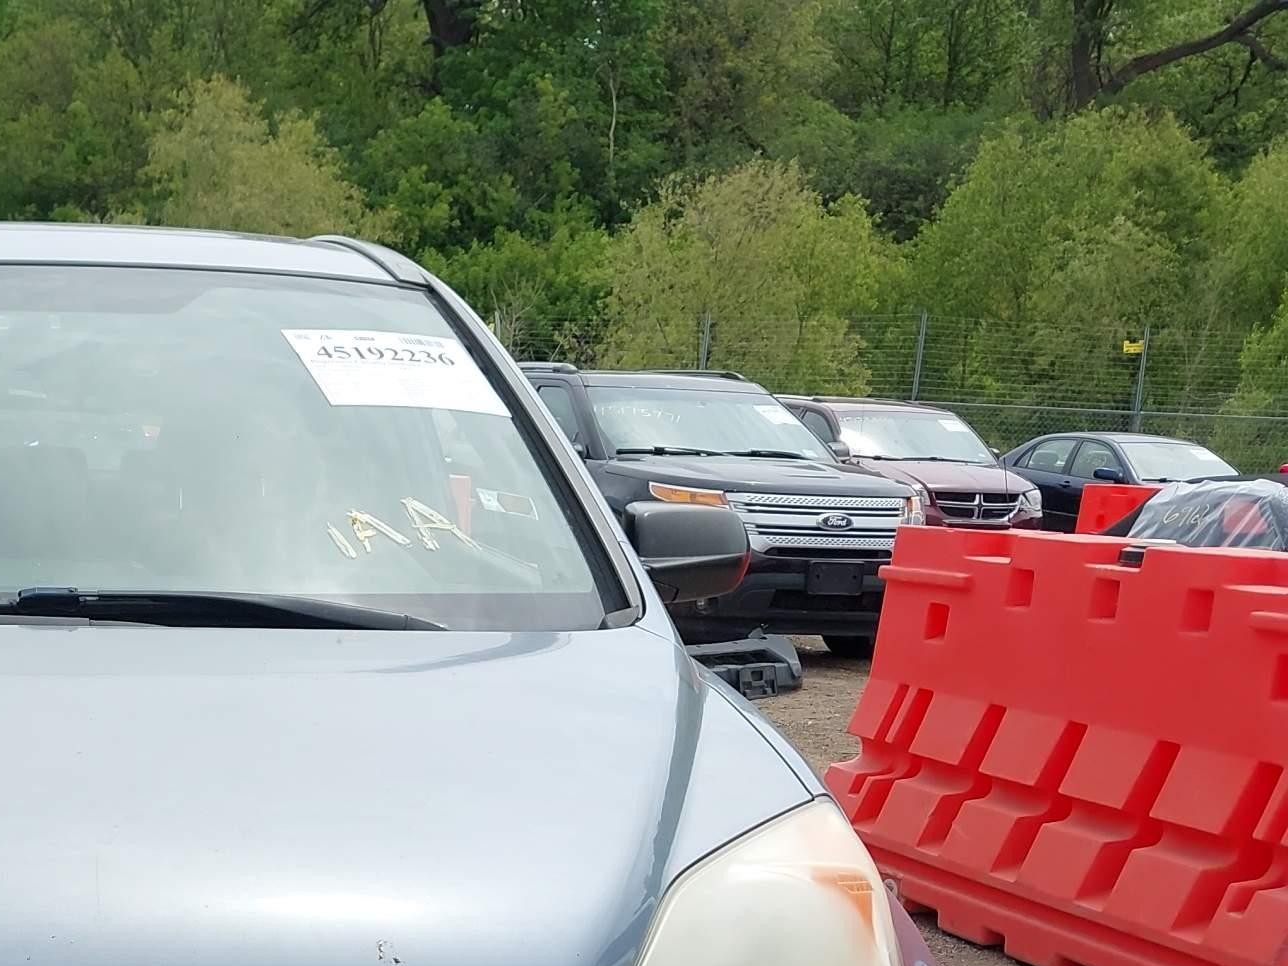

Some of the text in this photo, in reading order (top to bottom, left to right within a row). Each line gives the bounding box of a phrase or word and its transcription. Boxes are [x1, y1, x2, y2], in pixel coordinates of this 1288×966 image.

[316, 345, 456, 366] 45192236
[326, 496, 483, 559] IAA
[827, 516, 848, 527] Ford
